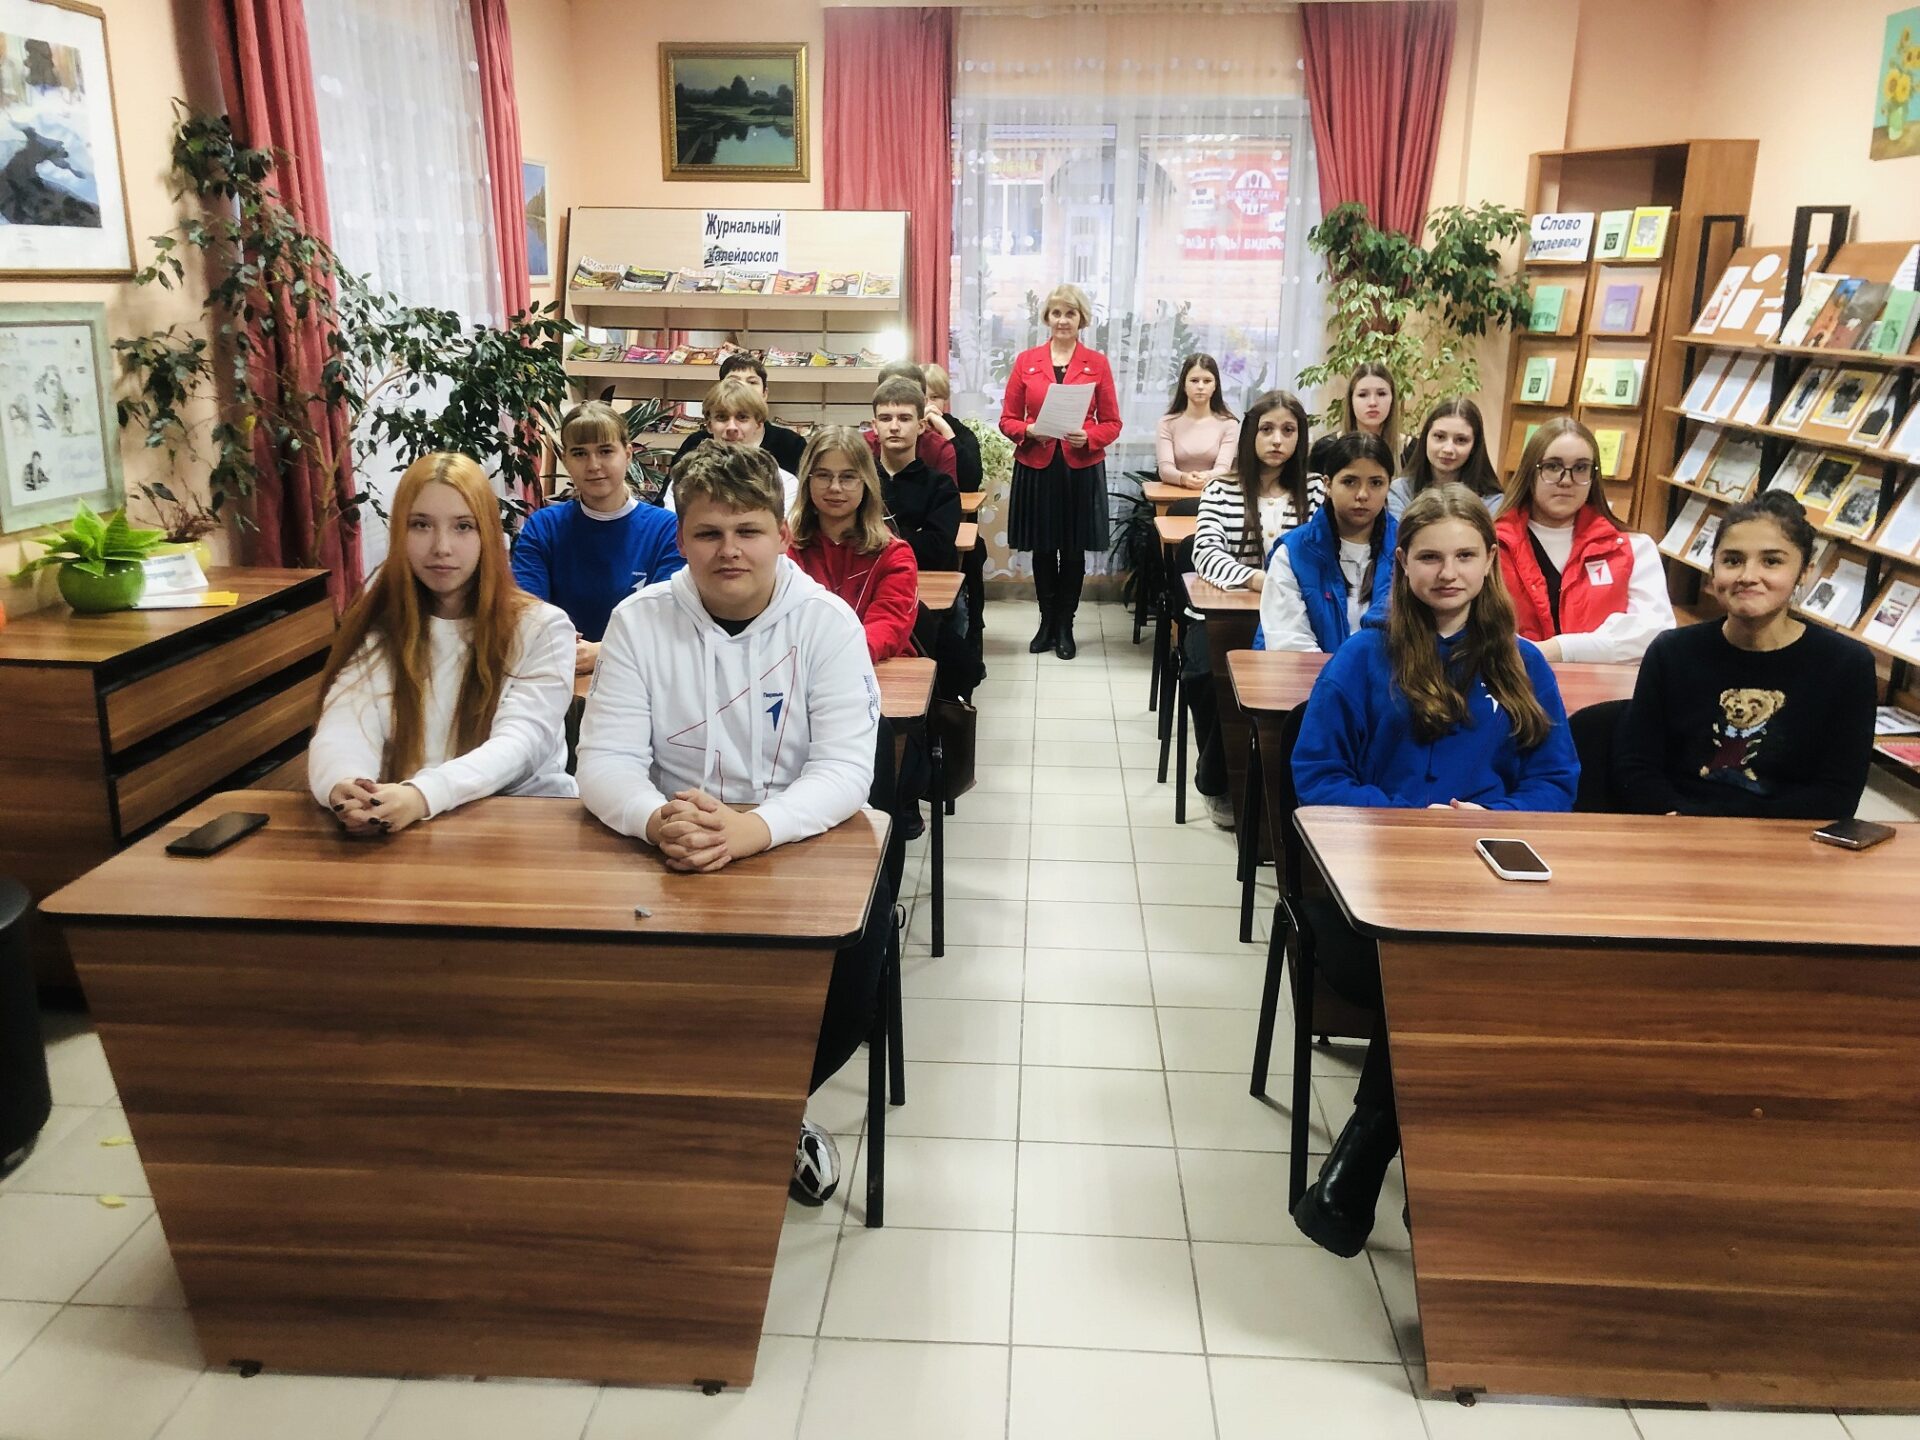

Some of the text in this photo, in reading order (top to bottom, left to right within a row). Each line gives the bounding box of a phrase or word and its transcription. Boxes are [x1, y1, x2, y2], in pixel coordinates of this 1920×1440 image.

[705, 213, 781, 240] Журнальный
[1540, 215, 1582, 231] Слово
[709, 247, 779, 264] калейдоскоп
[1531, 238, 1583, 257] краеведу
